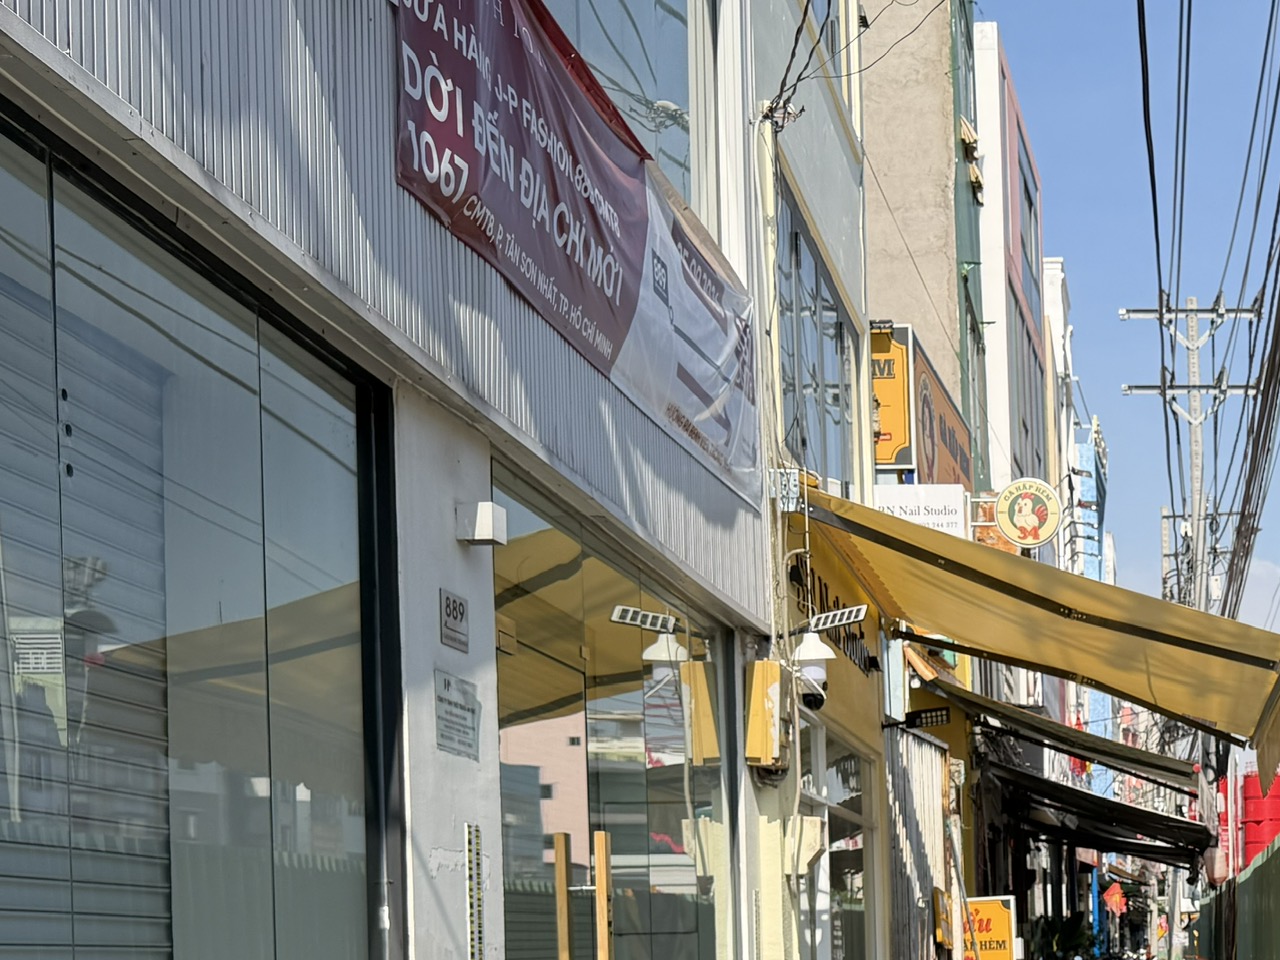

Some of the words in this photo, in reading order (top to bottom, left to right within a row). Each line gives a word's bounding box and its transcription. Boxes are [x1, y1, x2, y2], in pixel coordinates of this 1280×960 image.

[402, 40, 463, 138] DỜI
[453, 17, 492, 91] HÀNG
[494, 74, 518, 114] J-P
[522, 98, 573, 182] FASHION
[407, 119, 469, 204] 1067
[520, 252, 537, 286] SƠN
[559, 293, 569, 319] TP.
[593, 329, 613, 360] MINH
[472, 100, 514, 192] ĐẾN
[520, 157, 550, 233] ĐỊA
[553, 202, 587, 268] CHỈ
[587, 237, 623, 306] MỚI
[899, 505, 920, 516] Nail
[923, 504, 957, 516] Studio
[1017, 526, 1040, 540] 34
[445, 596, 465, 623] 889
